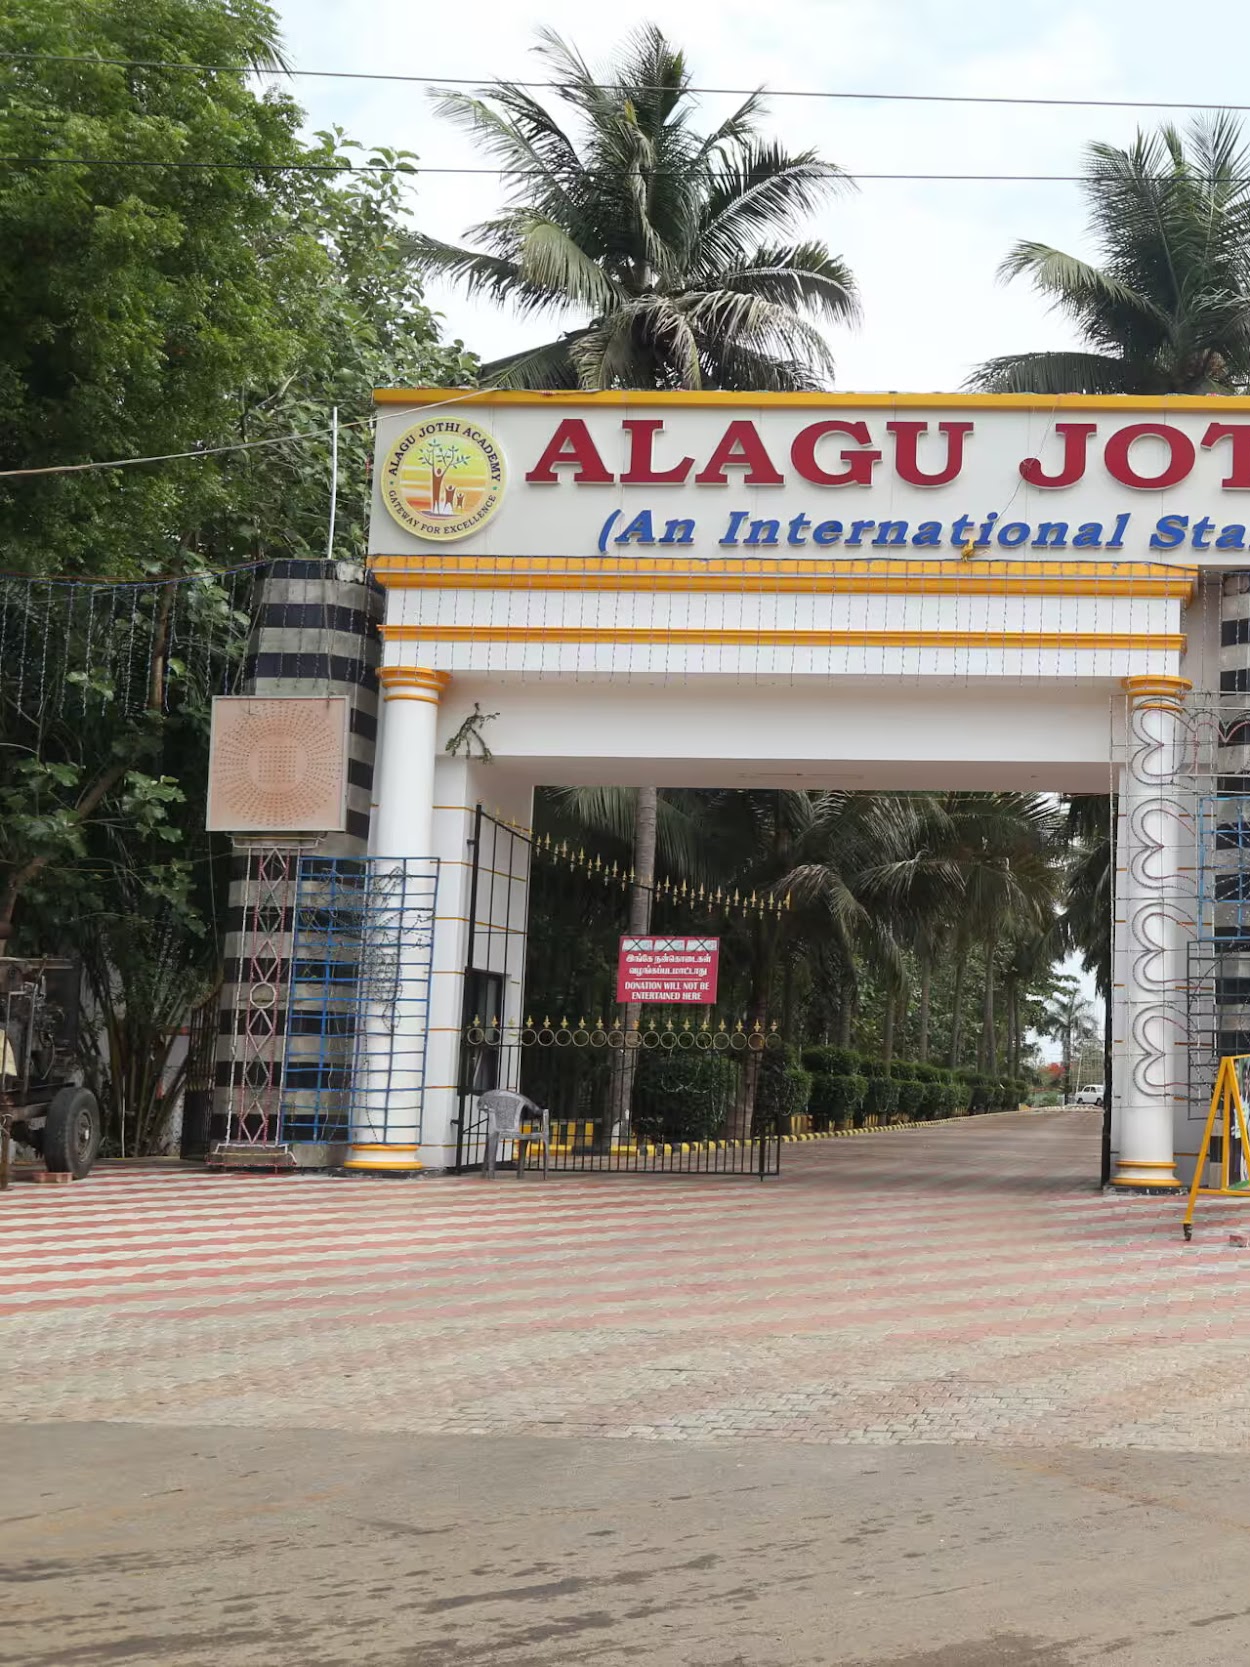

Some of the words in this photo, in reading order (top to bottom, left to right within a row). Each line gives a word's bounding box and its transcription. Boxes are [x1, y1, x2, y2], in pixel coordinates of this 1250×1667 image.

[388, 435, 416, 476] ALAGU
[419, 422, 461, 438] JOTHI
[462, 427, 501, 482] ACADEMY
[525, 418, 976, 488] ALAGU
[388, 490, 420, 527] GATEWAY
[421, 524, 440, 534] FOR
[443, 495, 496, 534] EXCELLENCE
[598, 508, 696, 553] (An
[718, 510, 1132, 549] International
[625, 982, 661, 990] DONATION
[664, 982, 681, 990] WILL
[683, 982, 697, 990] NOT
[700, 982, 710, 990] BE
[632, 992, 680, 1000] ENTERTAINED
[682, 992, 702, 1000] HERE
